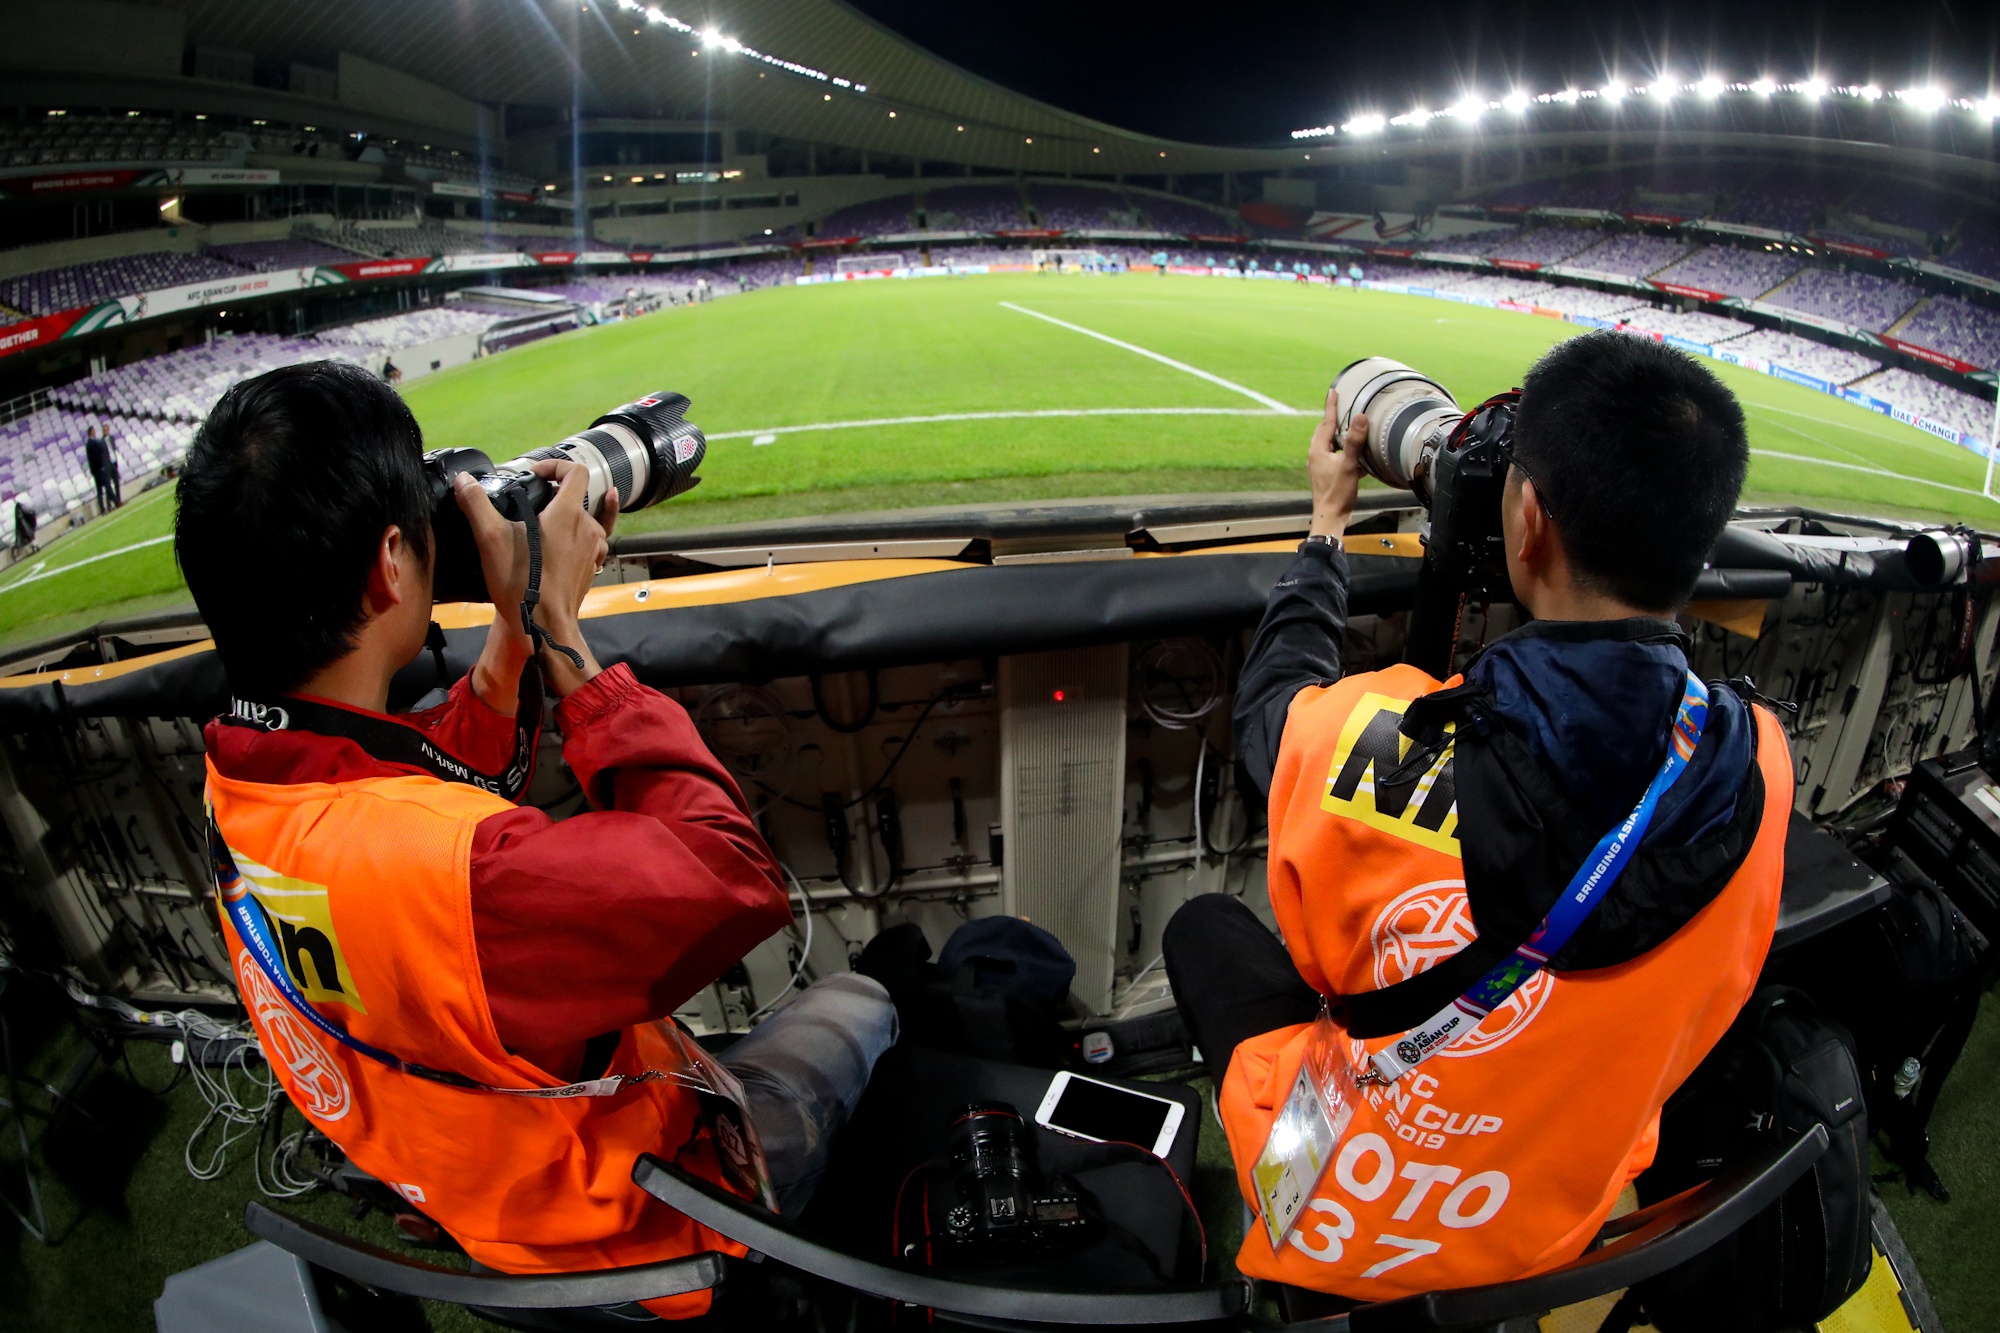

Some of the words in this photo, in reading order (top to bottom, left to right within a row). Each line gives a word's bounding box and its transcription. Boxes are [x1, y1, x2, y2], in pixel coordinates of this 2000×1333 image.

[187, 291, 201, 301] AFC
[203, 286, 223, 298] ASIAN
[224, 285, 237, 295] CUP
[239, 282, 252, 292] UAE
[231, 694, 289, 731] Can
[421, 742, 434, 759] IV
[434, 751, 469, 780] Mark
[1575, 842, 1622, 903] BRINGING
[1617, 812, 1639, 844] ASIA
[238, 905, 274, 967] TOGETHER
[273, 964, 292, 994] ASIA
[1413, 1031, 1427, 1044] AFC
[1417, 1029, 1444, 1050] ASIAN
[1440, 1016, 1460, 1033] CUP
[1422, 1044, 1436, 1054] UAE
[1434, 1033, 1450, 1047] 2019
[1384, 1108, 1446, 1150] 2019
[1414, 1103, 1503, 1136] CUP
[1335, 1132, 1511, 1229] OTO
[1289, 1197, 1443, 1279] 37
